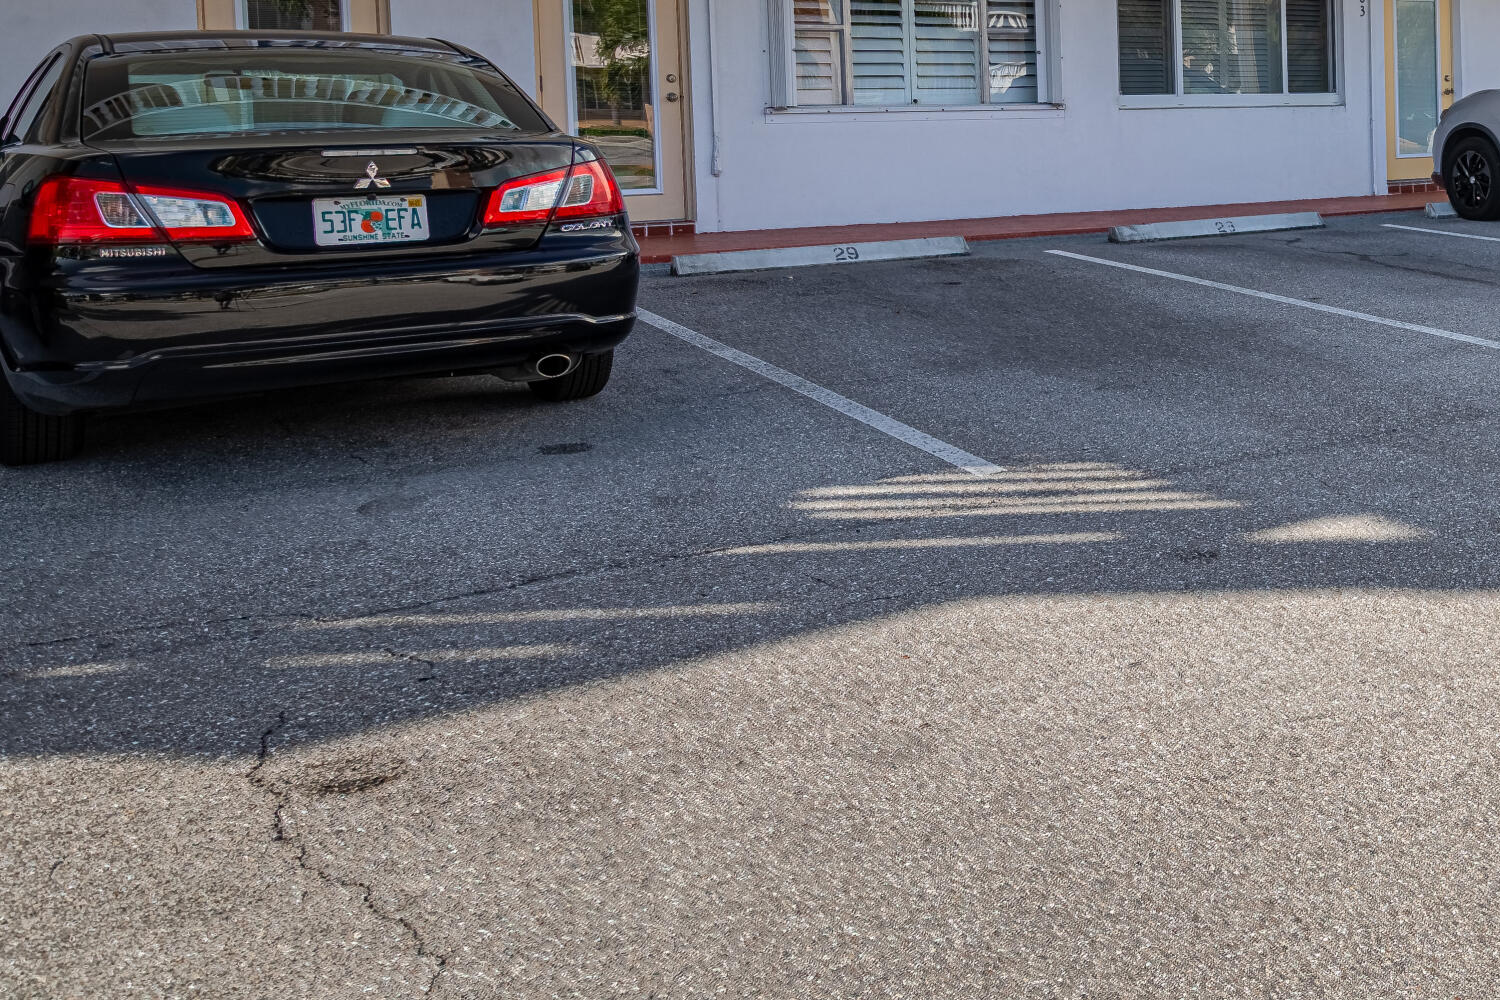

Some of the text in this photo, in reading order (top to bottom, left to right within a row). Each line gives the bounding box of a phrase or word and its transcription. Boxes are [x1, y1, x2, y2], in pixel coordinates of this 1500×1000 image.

[321, 207, 422, 234] 53F EFA
[343, 231, 405, 241] SUNSHINE STATE
[100, 247, 166, 258] MITSUBISHI
[833, 246, 859, 261] 29
